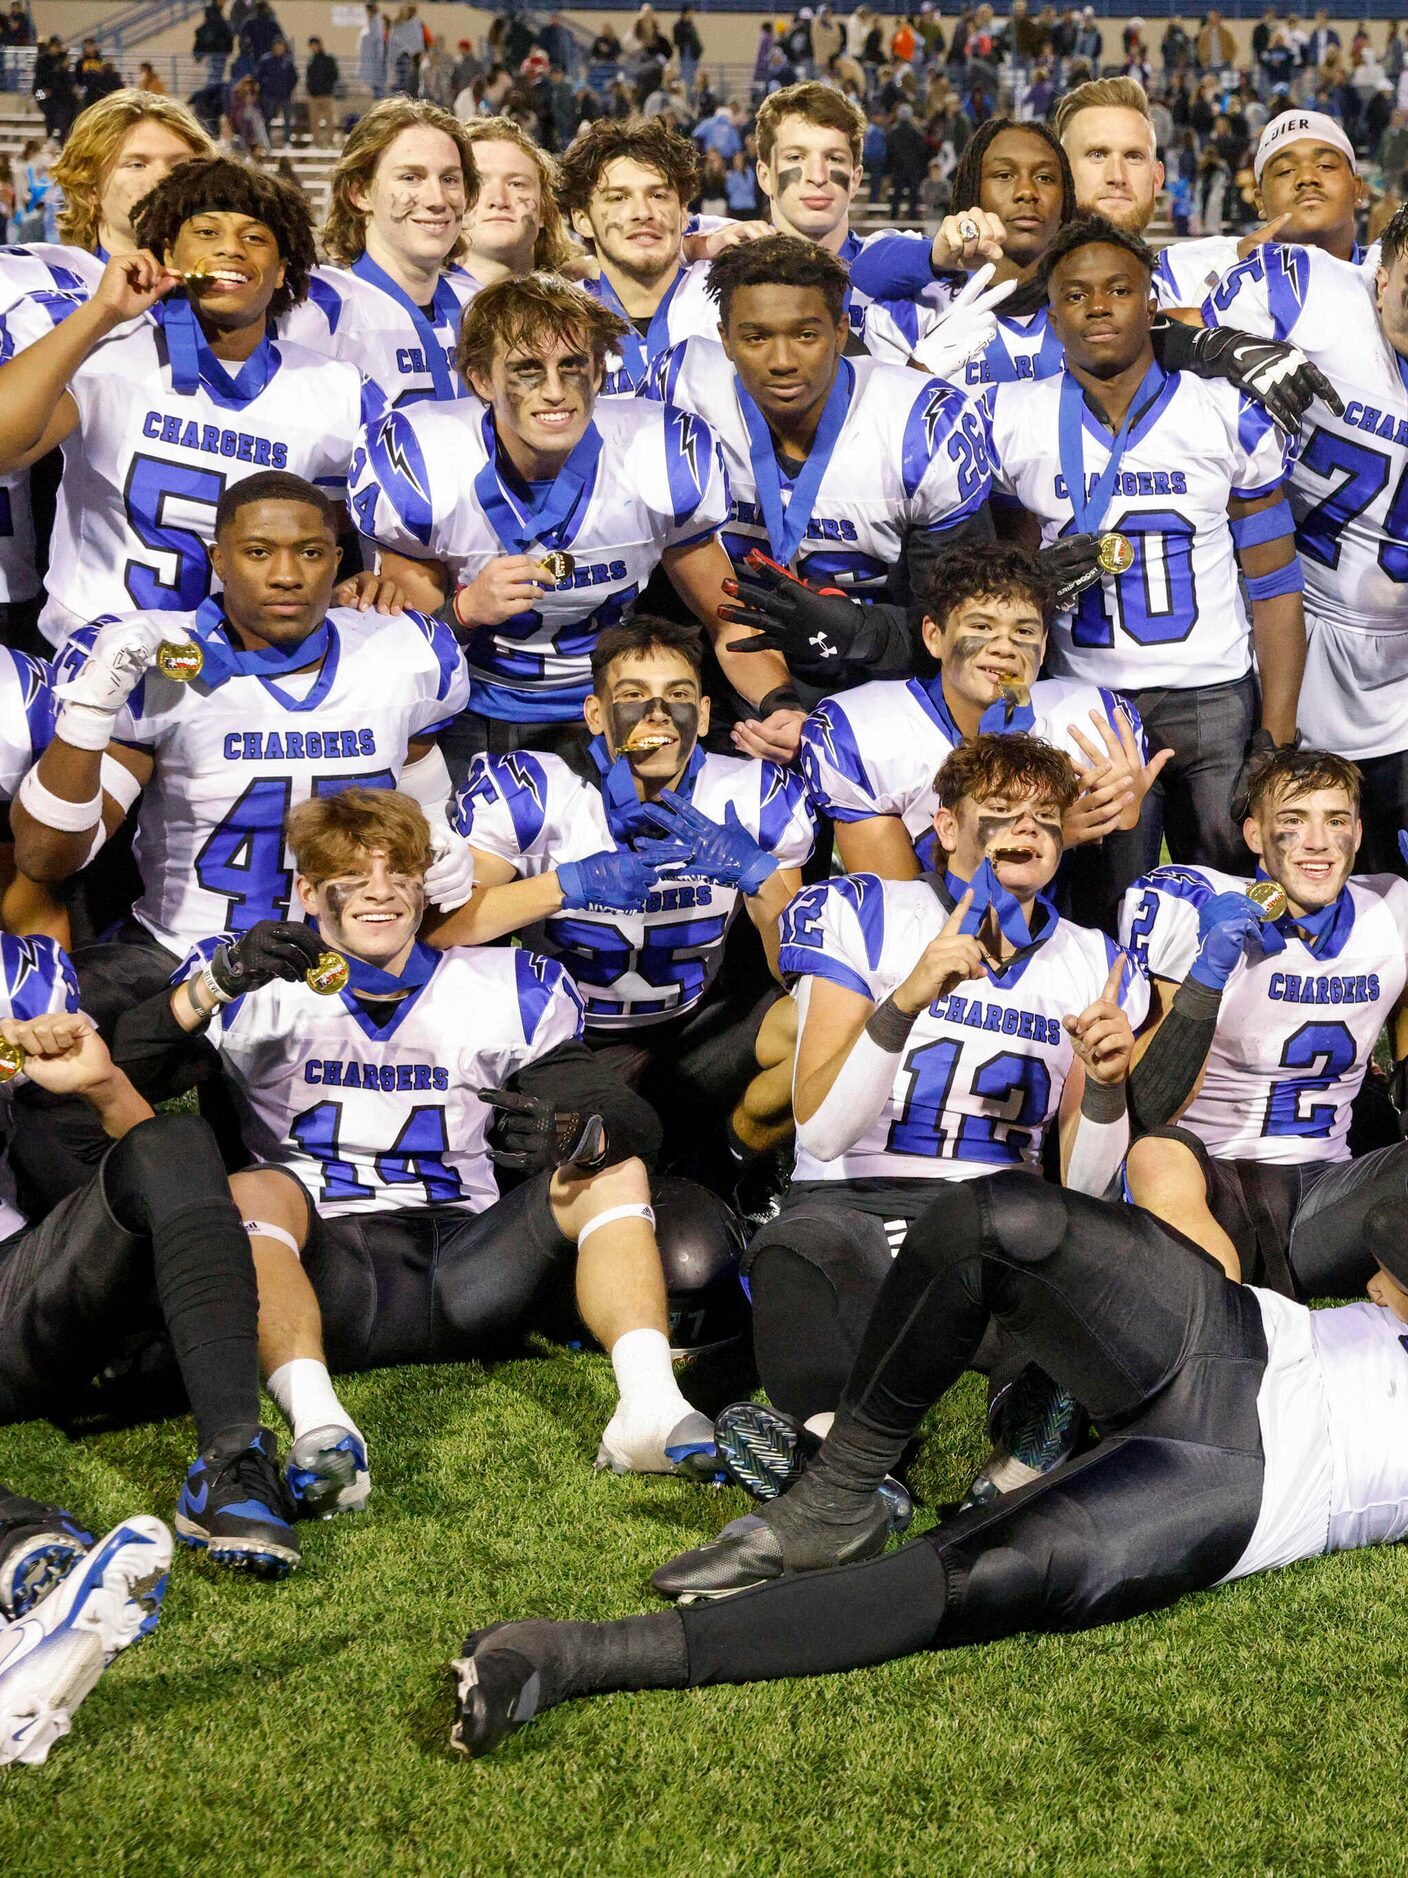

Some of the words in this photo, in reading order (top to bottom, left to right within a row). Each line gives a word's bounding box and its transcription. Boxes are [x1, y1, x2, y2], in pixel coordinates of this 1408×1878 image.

[143, 411, 289, 470] CHARGERS
[124, 451, 228, 611] 5
[224, 728, 376, 760] CHARGERS
[1129, 886, 1161, 964] 2
[1267, 972, 1380, 1004] CHARGERS
[929, 994, 1061, 1046] CHARGERS
[304, 1058, 450, 1092] CHARGERS
[1260, 1019, 1358, 1138] 2
[287, 1099, 470, 1204] 14
